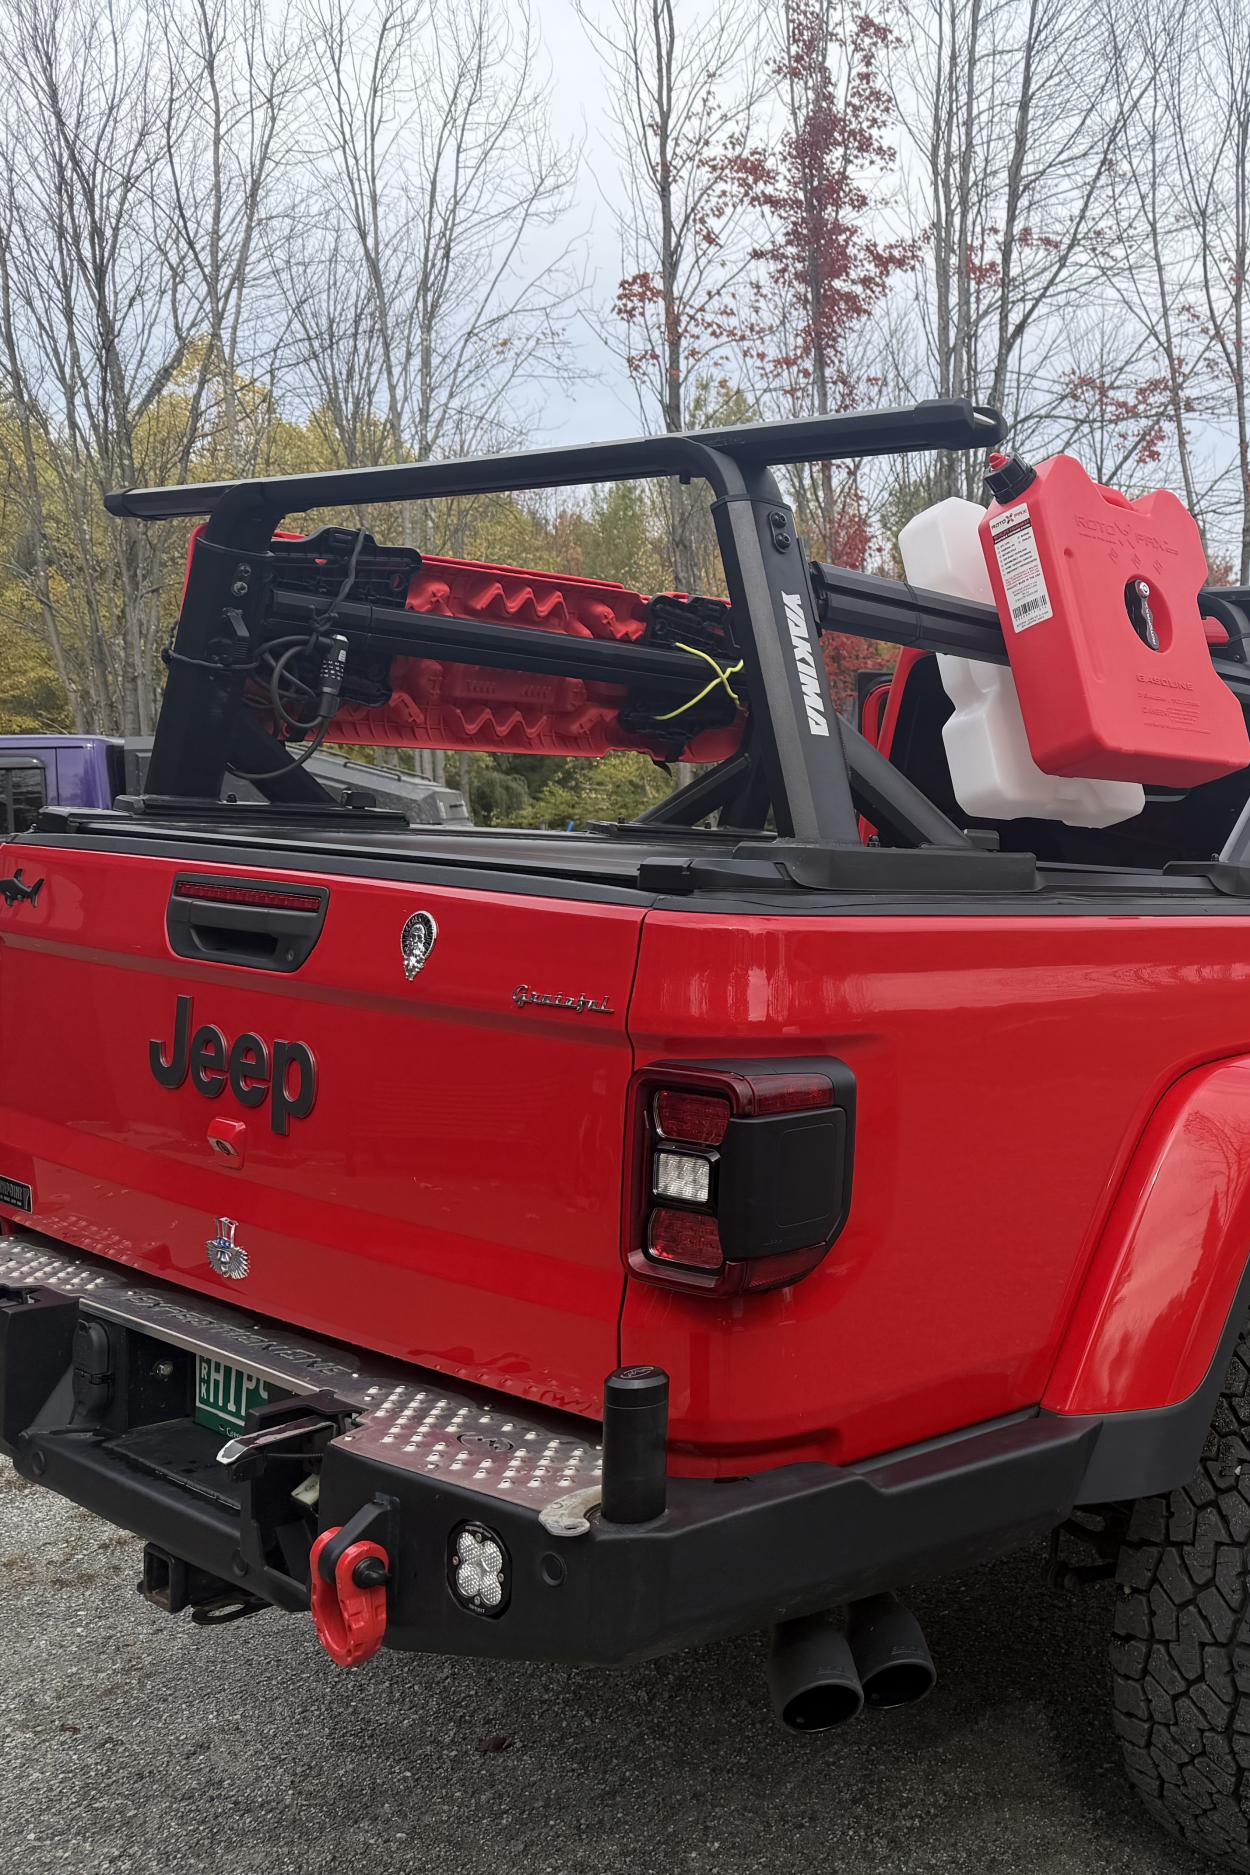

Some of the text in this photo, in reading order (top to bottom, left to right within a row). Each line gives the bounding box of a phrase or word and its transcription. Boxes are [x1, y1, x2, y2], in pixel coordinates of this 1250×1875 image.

[781, 591, 829, 736] YAKIMA
[148, 994, 317, 1136] Jeep
[512, 984, 615, 1013] Grateful
